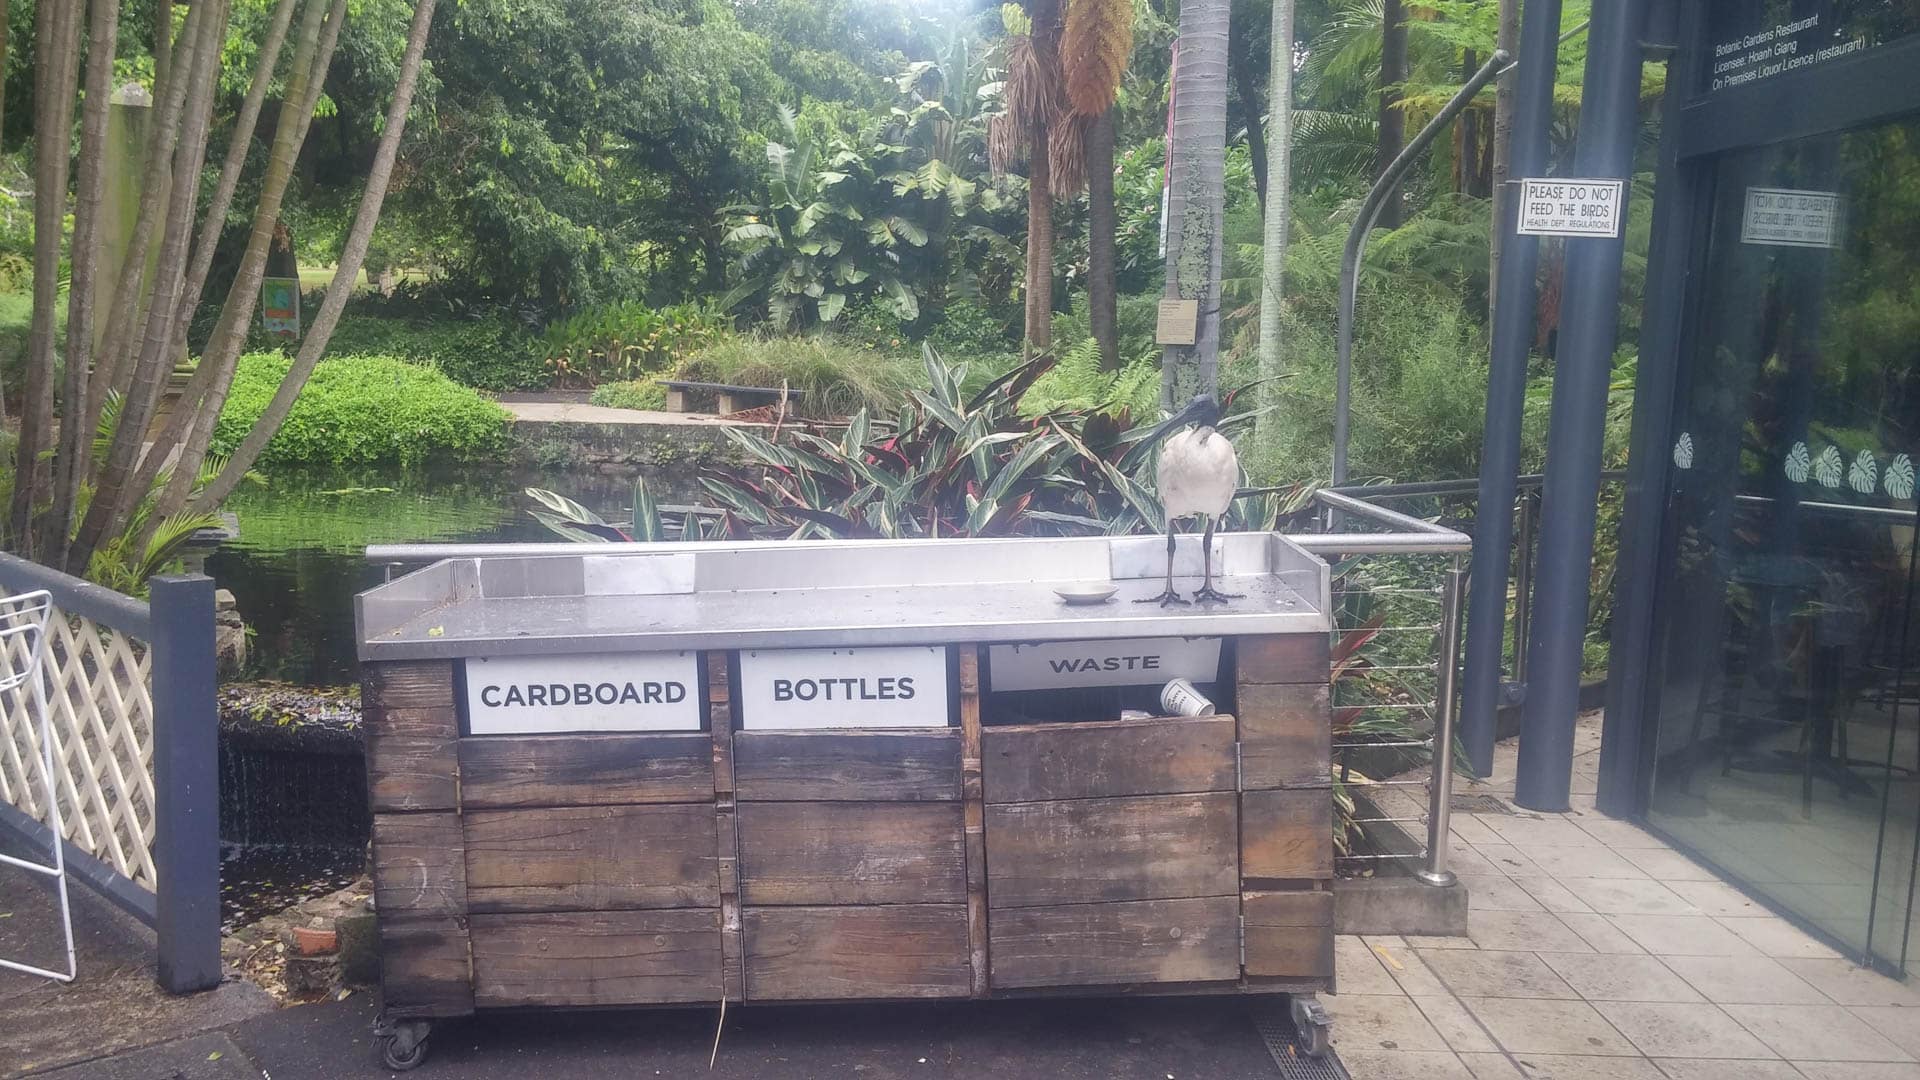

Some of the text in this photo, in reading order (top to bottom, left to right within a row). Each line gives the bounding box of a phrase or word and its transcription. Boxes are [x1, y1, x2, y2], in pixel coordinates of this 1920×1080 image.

[1716, 13, 1819, 57] Botanic Gardens Restaurant
[1712, 35, 1865, 91] On Premises Liquor Licence (restaurant)
[1748, 48, 1772, 64] Hoanh
[1774, 40, 1798, 56] Giang
[1529, 185, 1614, 201] PLEASE DO NOT
[1530, 202, 1609, 217] FEED THE BIRDS
[1526, 218, 1548, 227] HEALTH
[1569, 220, 1610, 229] REGULATIONS
[1049, 655, 1160, 674] WASTE
[481, 681, 686, 708] CARDBOARD
[773, 677, 916, 702] BOTTLES
